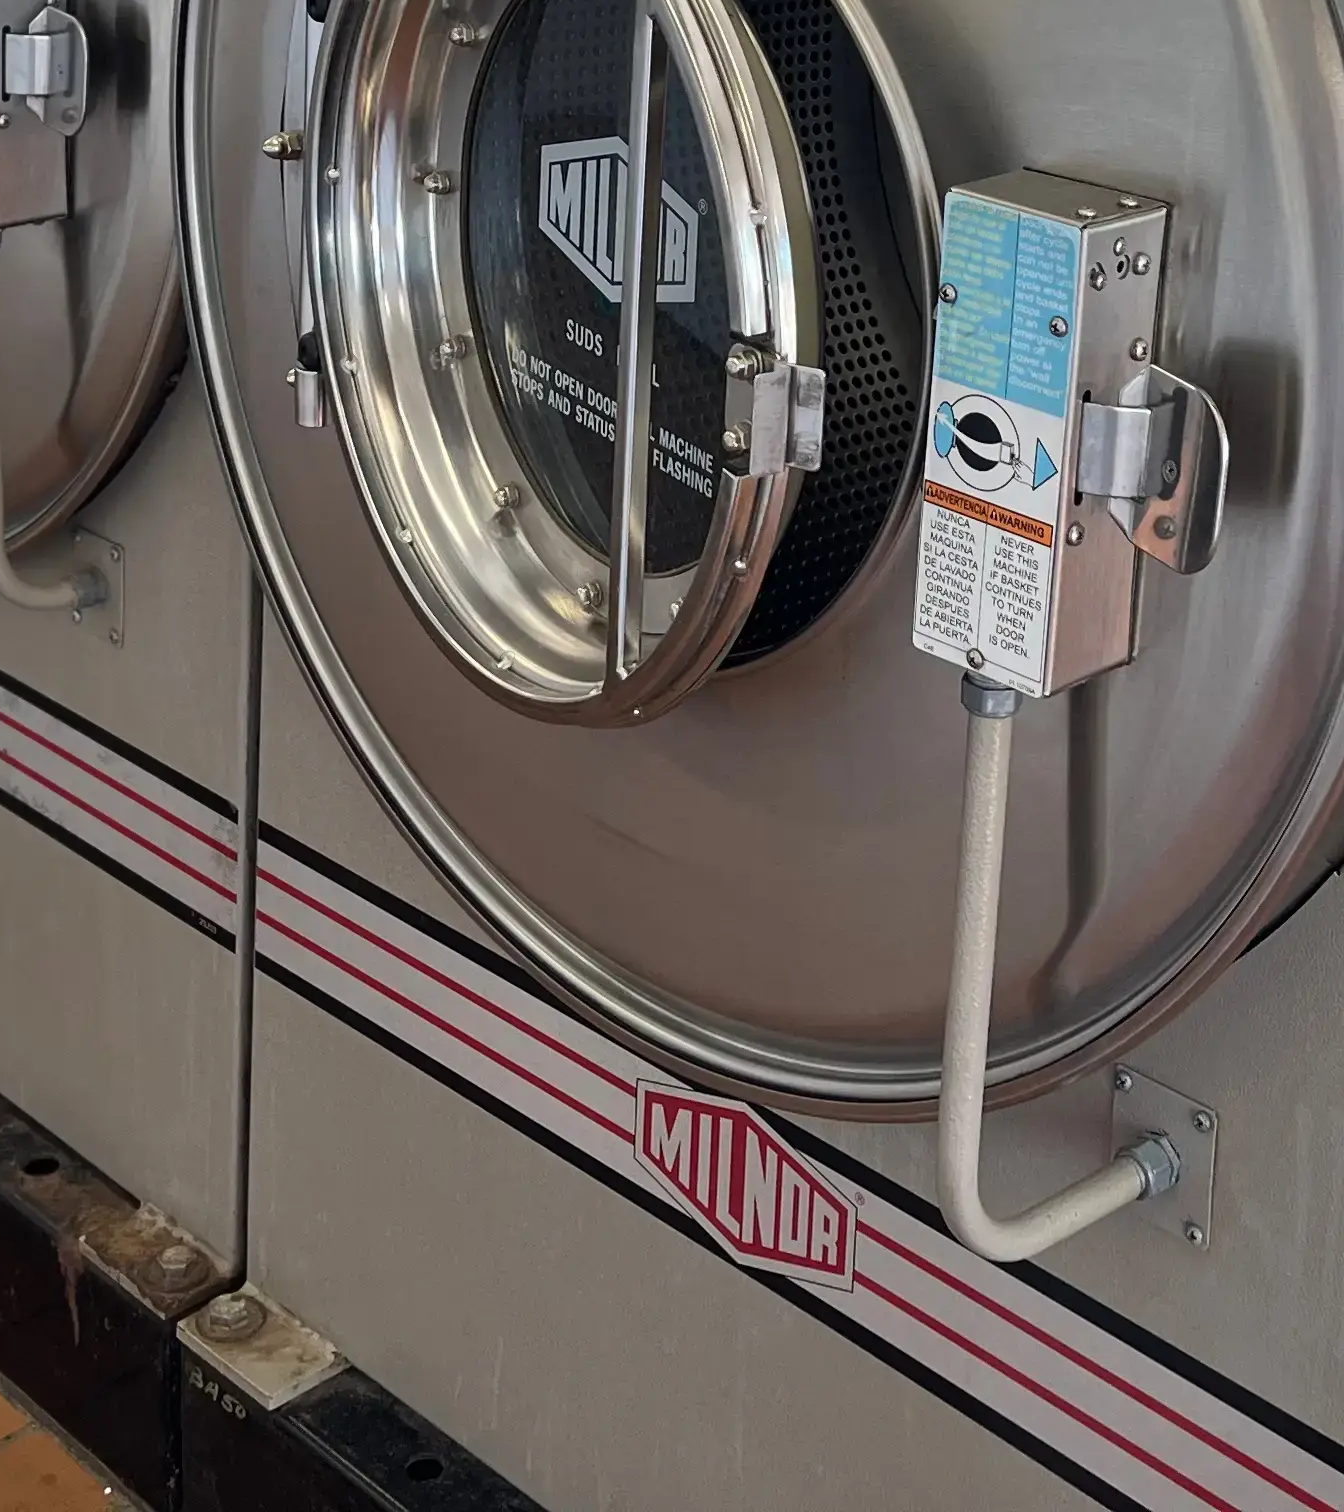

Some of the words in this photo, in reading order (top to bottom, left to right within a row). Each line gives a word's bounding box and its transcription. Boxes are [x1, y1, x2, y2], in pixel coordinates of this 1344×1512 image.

[550, 156, 687, 285] MILR
[566, 318, 604, 357] SUDS
[512, 343, 527, 369] DO
[530, 355, 551, 381] NOT
[555, 368, 584, 400] OPEN
[587, 387, 618, 419] DOOR
[511, 368, 544, 401] STOPS
[548, 388, 572, 418] AND
[575, 406, 615, 443] STATUS
[659, 427, 714, 475] MACHINE
[653, 447, 713, 499] FLASHING
[932, 487, 987, 517] ADVERTENCIA
[930, 519, 949, 534] USE
[952, 527, 975, 543] ESTA
[937, 509, 970, 529] NUNCA
[998, 512, 1045, 538] WARNING
[924, 542, 932, 552] SI
[935, 546, 946, 559] LA
[948, 551, 978, 571] CESTA
[930, 532, 973, 556] MAQUINA
[1000, 535, 1034, 555] NEVER
[924, 555, 937, 568] DE
[940, 561, 976, 583] LAVADO
[993, 558, 1038, 583] MACHINE
[995, 545, 1014, 561] USE
[1017, 554, 1039, 570] THIS
[925, 569, 973, 595] CONTINUA
[927, 582, 970, 605] GIRANDO
[990, 570, 998, 582] IF
[1001, 574, 1039, 597] BASKET
[925, 594, 969, 619] DESPUES
[985, 582, 1042, 611] CONTINUES
[991, 596, 1005, 609] TO
[1007, 602, 1034, 621] TURN
[920, 604, 932, 617] DE
[935, 610, 973, 633] ABIERTA
[920, 616, 931, 629] LA
[997, 612, 1026, 631] WHEN
[989, 634, 998, 646] IS
[1001, 639, 1030, 659] OPEN.
[996, 624, 1025, 643] DOOR
[650, 1102, 840, 1266] MILNOR
